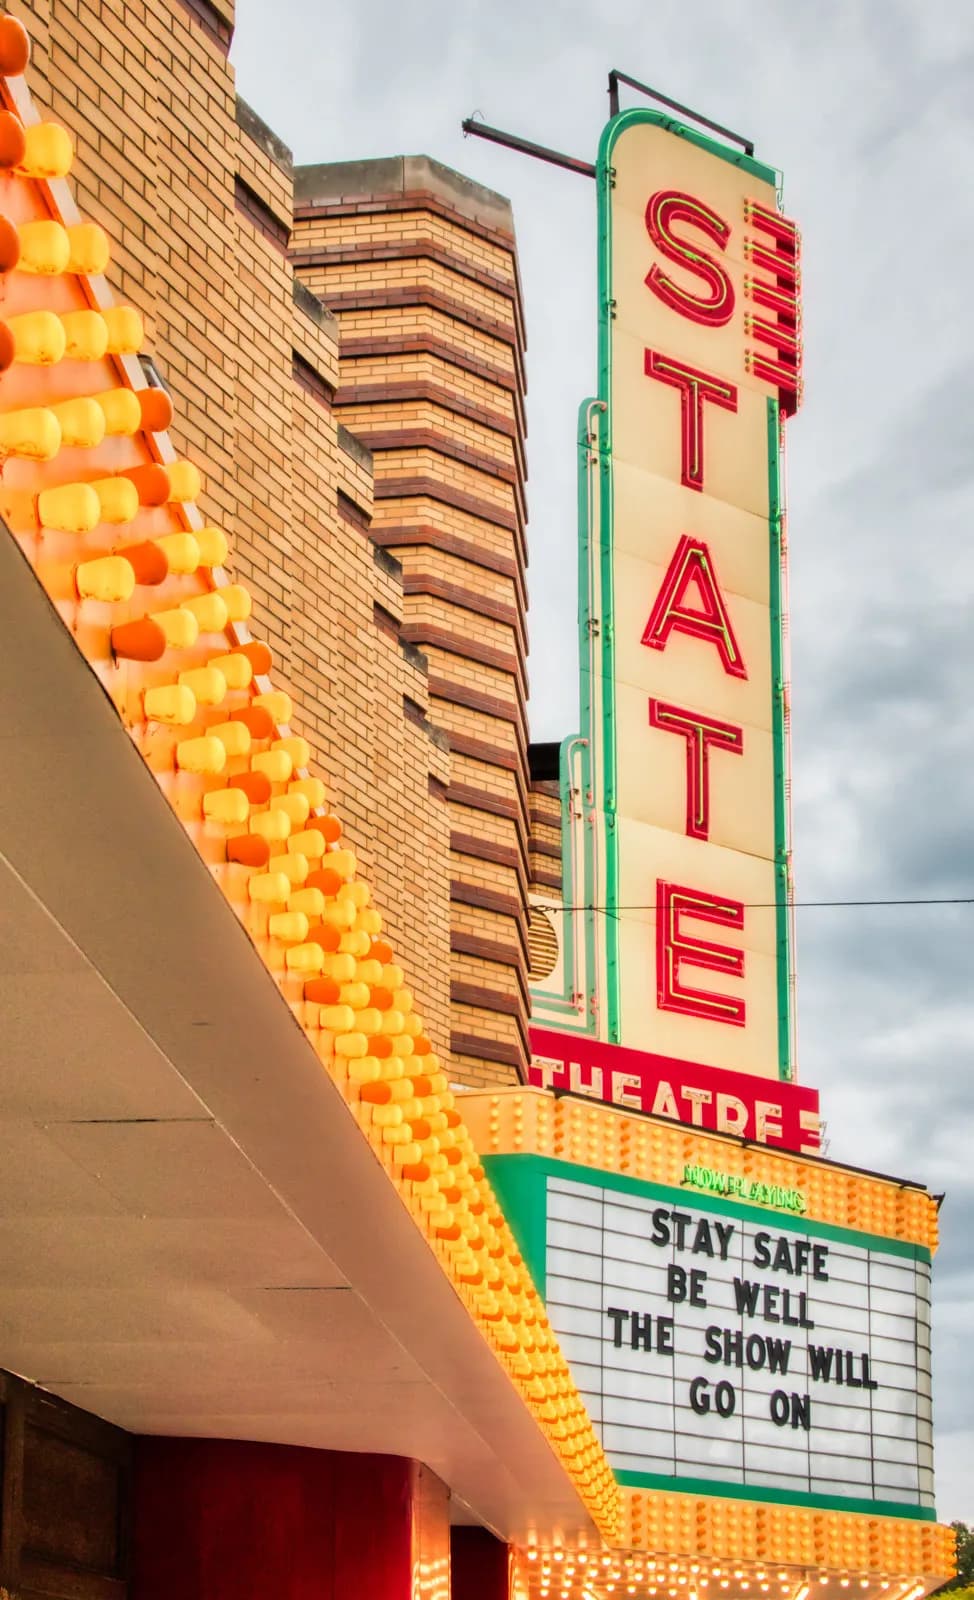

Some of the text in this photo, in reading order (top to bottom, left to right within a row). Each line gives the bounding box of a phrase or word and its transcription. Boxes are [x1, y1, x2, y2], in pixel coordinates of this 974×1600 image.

[640, 189, 748, 1029] STATE
[684, 1164, 806, 1213] NOW PLAYING
[651, 1208, 829, 1282] STAY SAFE
[667, 1264, 815, 1330] BE WELL
[607, 1307, 878, 1390] THE SHOW WILL
[689, 1377, 811, 1431] GO ON
